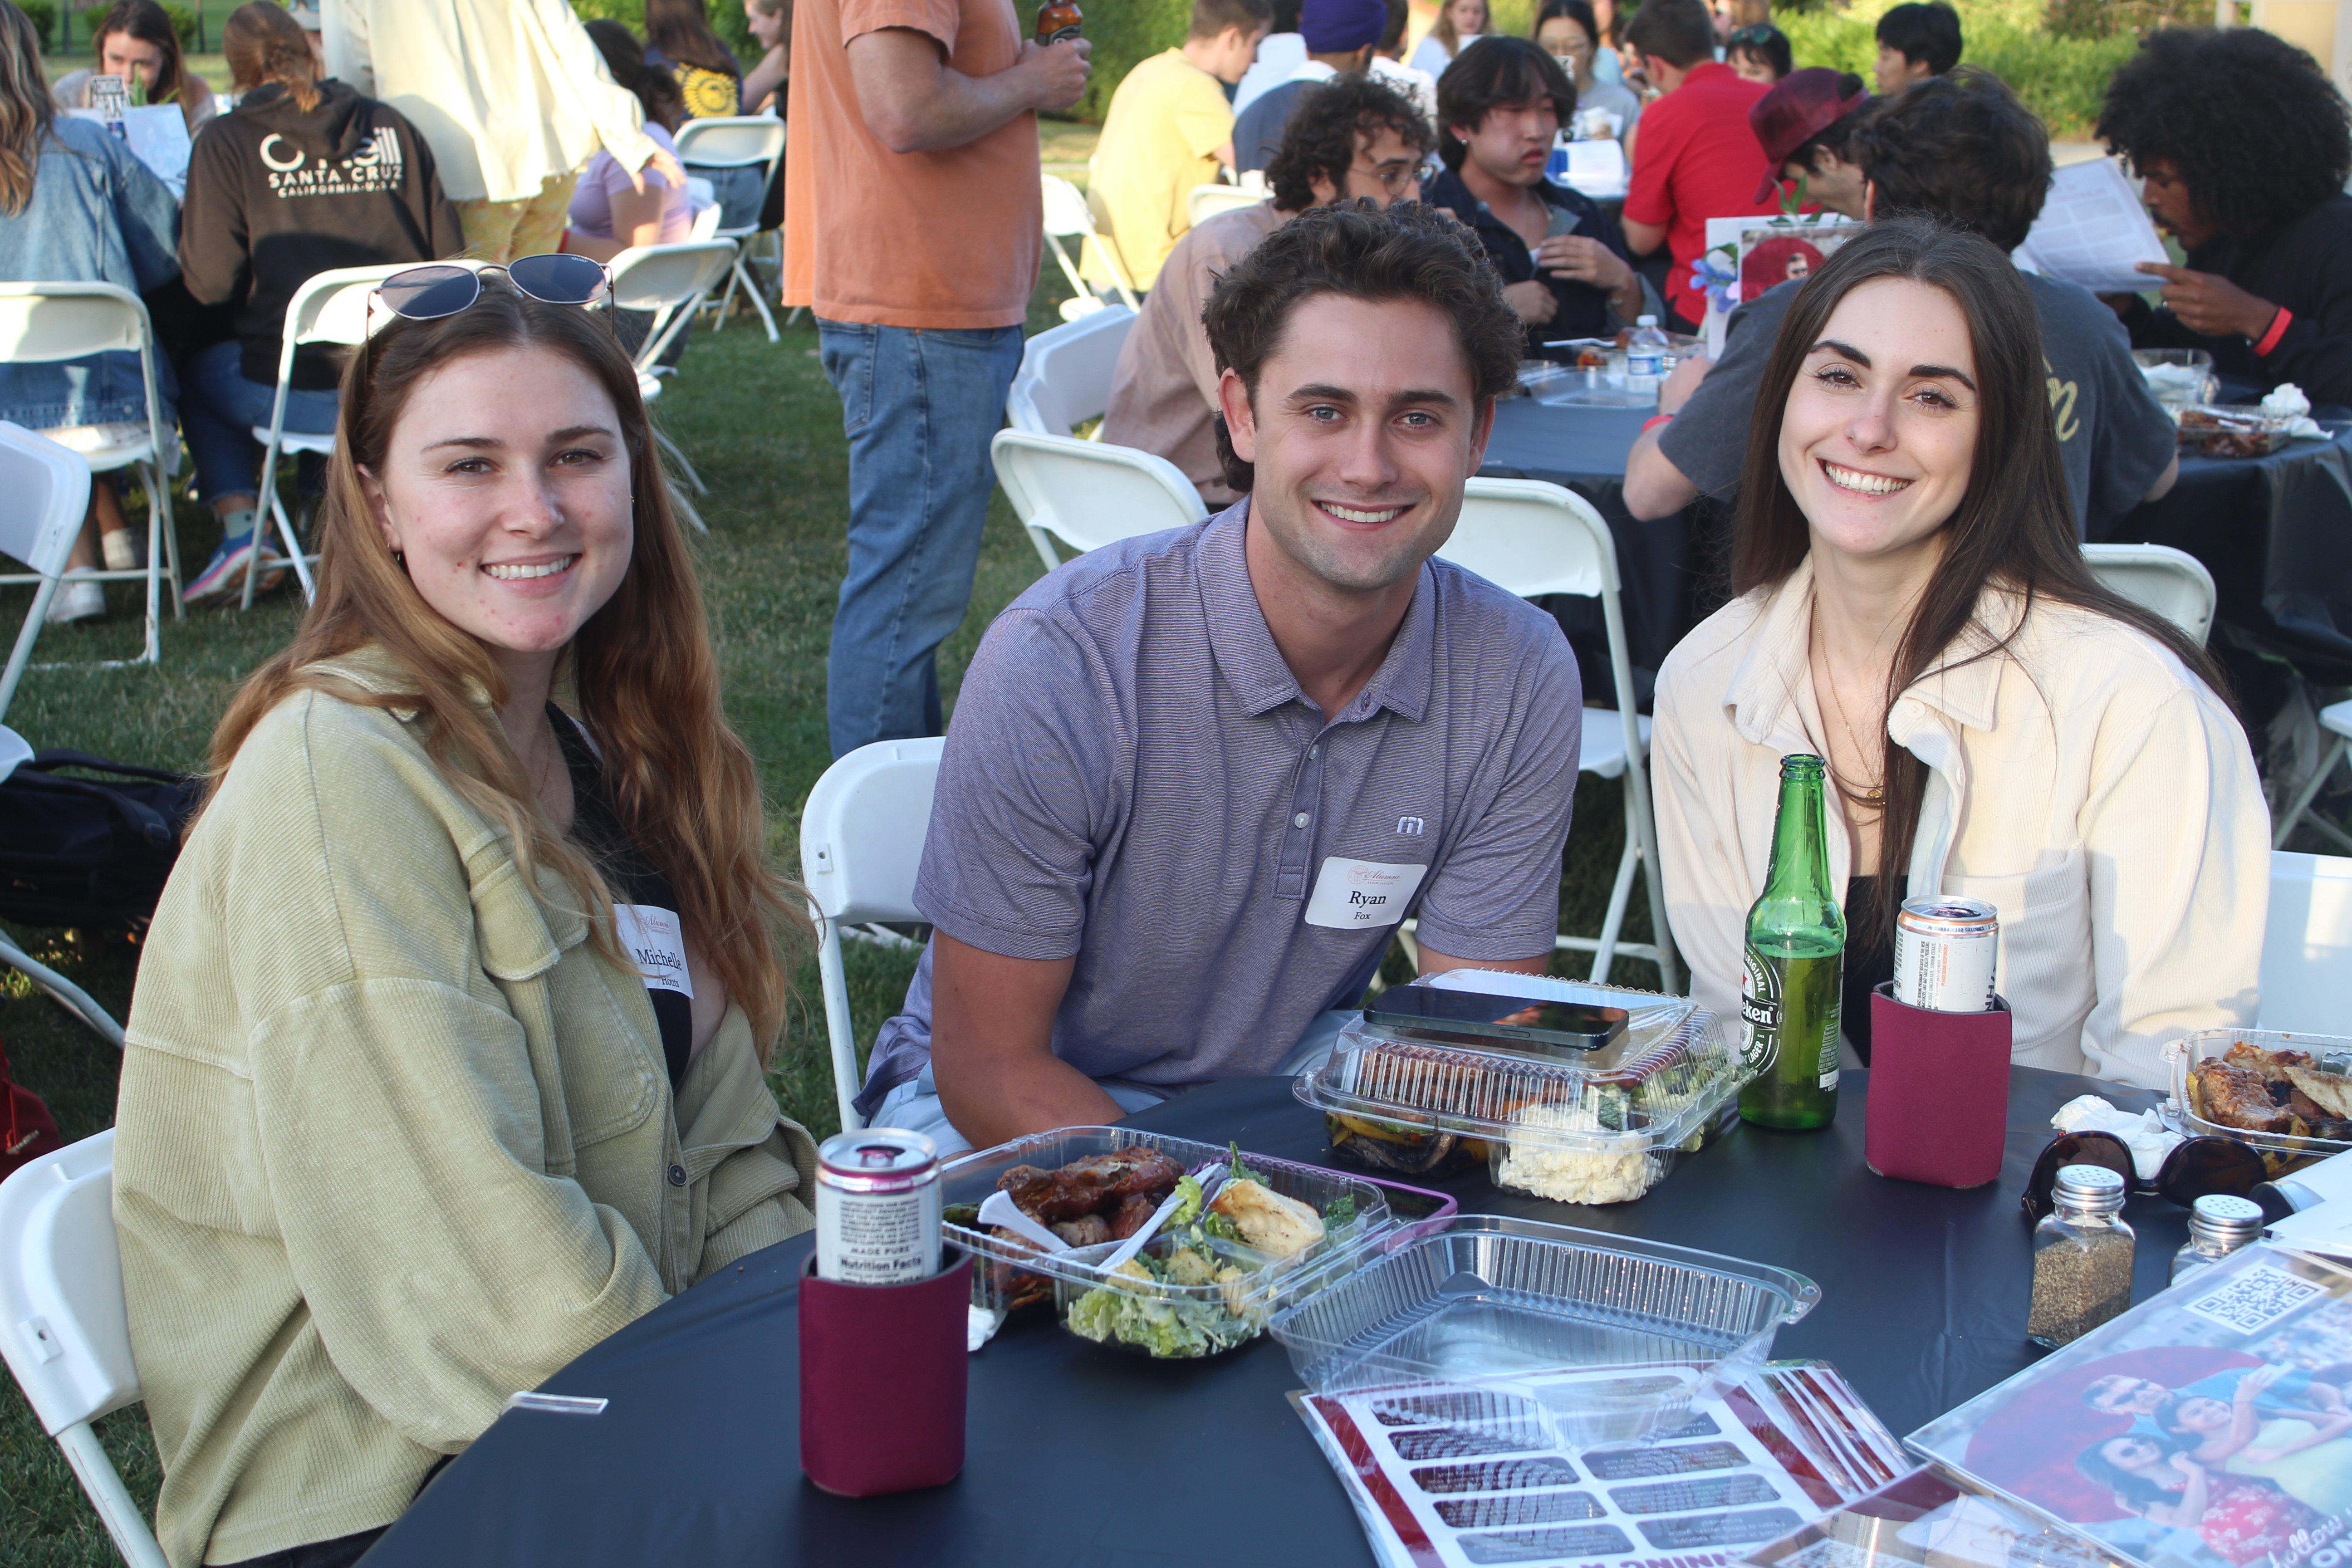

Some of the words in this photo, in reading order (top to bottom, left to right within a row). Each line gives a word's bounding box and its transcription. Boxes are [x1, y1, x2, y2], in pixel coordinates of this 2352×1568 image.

[260, 127, 402, 172] Oeill
[269, 168, 342, 189] SANTA
[351, 165, 402, 182] CRUZ
[1364, 869, 1401, 880] Alumni
[1348, 890, 1387, 908] Ryan
[1354, 911, 1371, 920] Fox
[635, 948, 682, 971] Michelle
[661, 975, 680, 988] Houts
[1745, 952, 1766, 992] ORIGINAL
[1742, 1000, 1772, 1024] eken
[1748, 1040, 1764, 1064] LAGER
[850, 1247, 880, 1255] MADE
[841, 1256, 890, 1270] Nutrition
[893, 1256, 922, 1269] Facts
